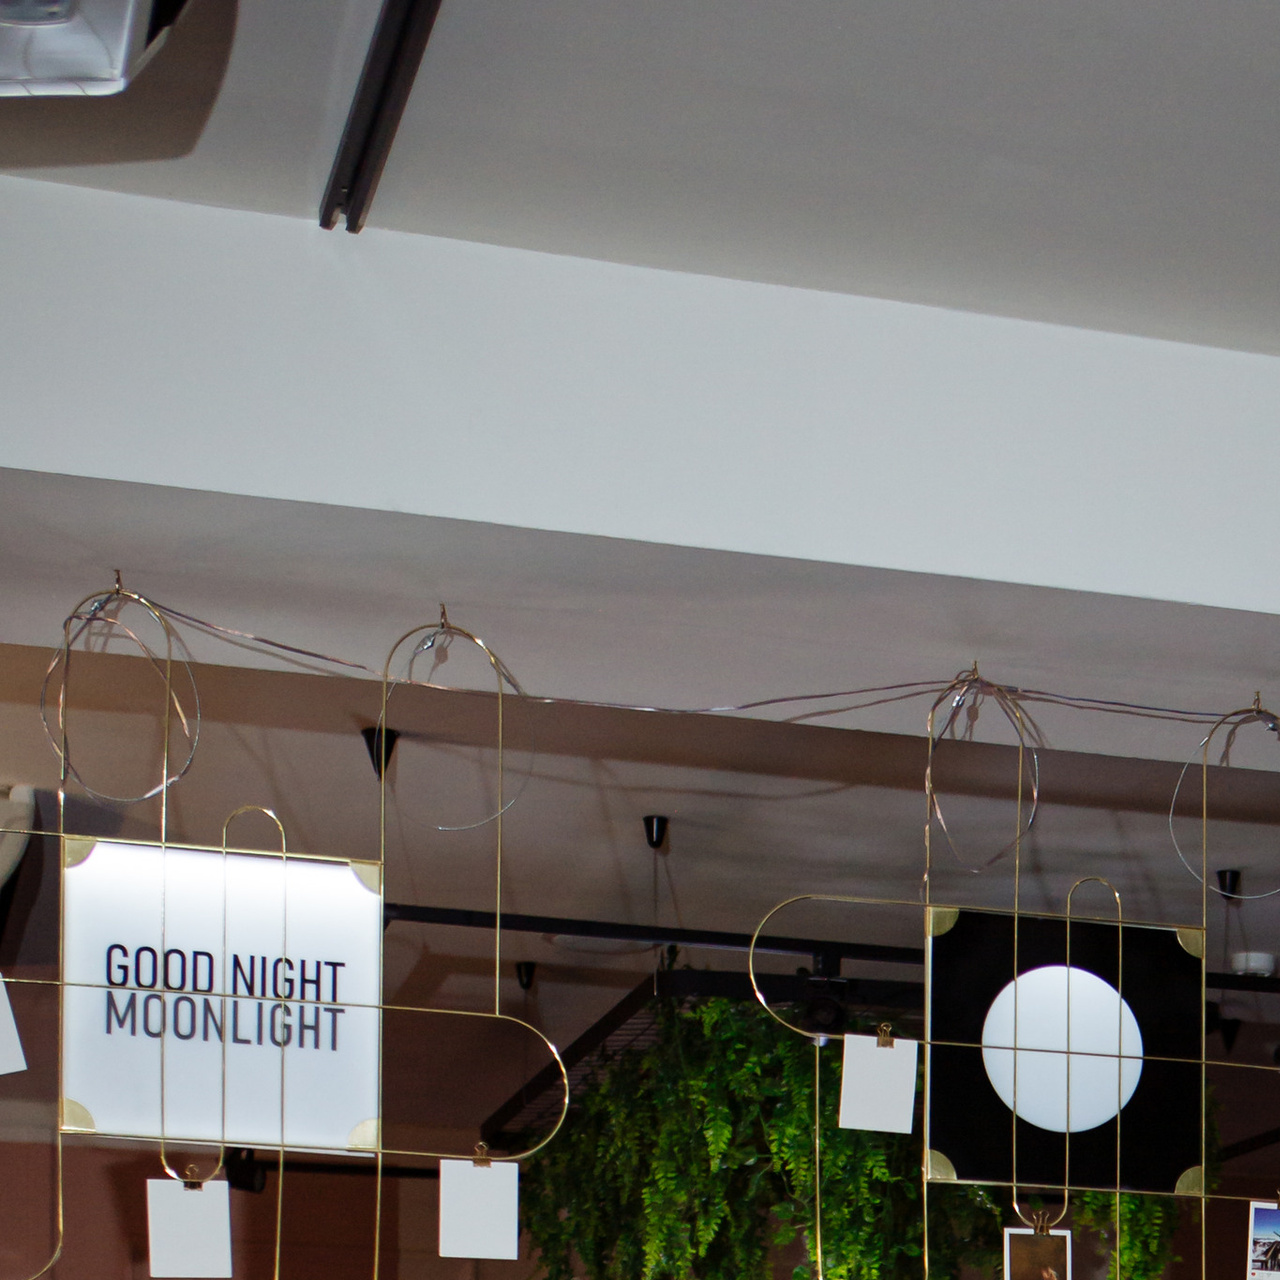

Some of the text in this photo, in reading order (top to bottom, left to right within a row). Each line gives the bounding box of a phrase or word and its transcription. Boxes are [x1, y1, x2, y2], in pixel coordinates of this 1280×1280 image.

[106, 944, 345, 1002] GOOD NIGHT
[106, 991, 345, 1051] MOONLIGHT
